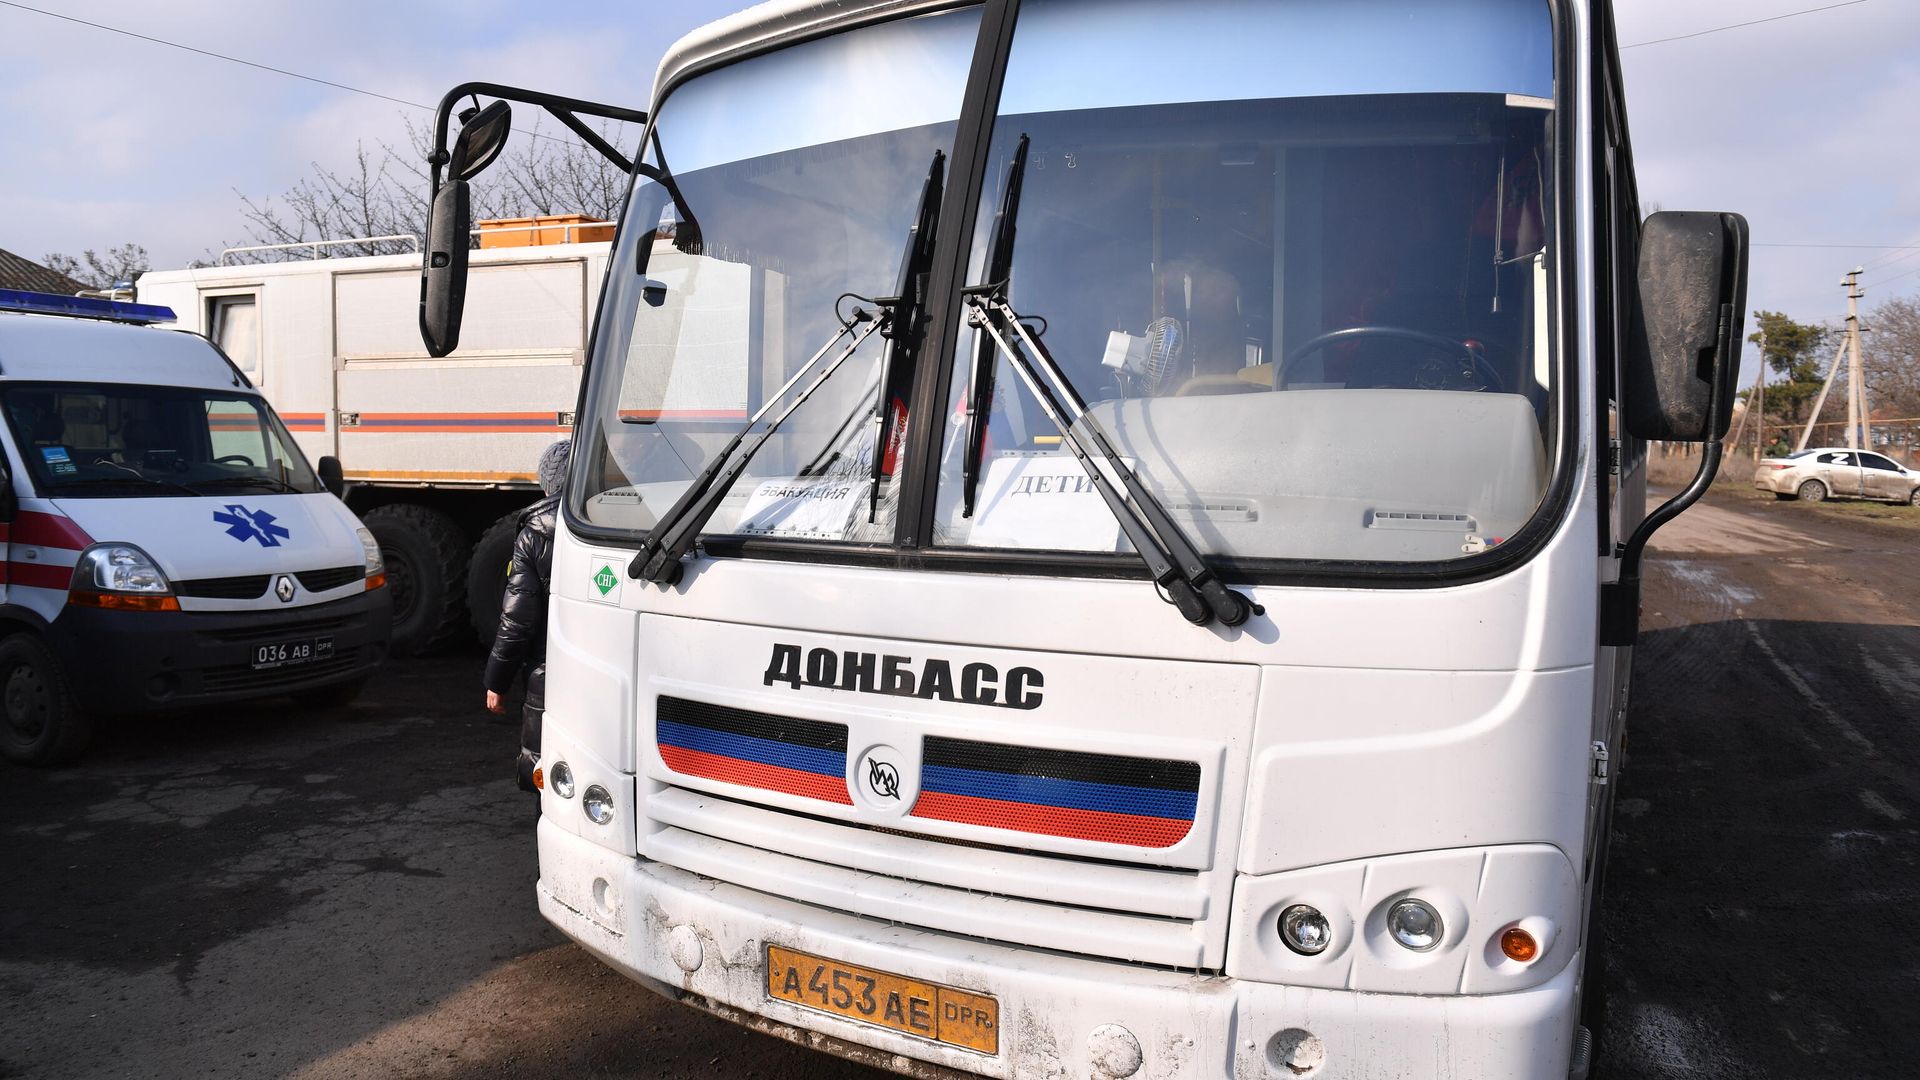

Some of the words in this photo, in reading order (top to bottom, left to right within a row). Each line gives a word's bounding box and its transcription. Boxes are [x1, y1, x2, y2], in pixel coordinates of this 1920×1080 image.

[759, 485, 851, 502] ЭВАКУАЦИЯ
[1011, 475, 1095, 498] ДЕТИ
[258, 644, 287, 663] 036
[763, 642, 1045, 711] ДОНБАСС
[943, 1001, 991, 1028] DPR
